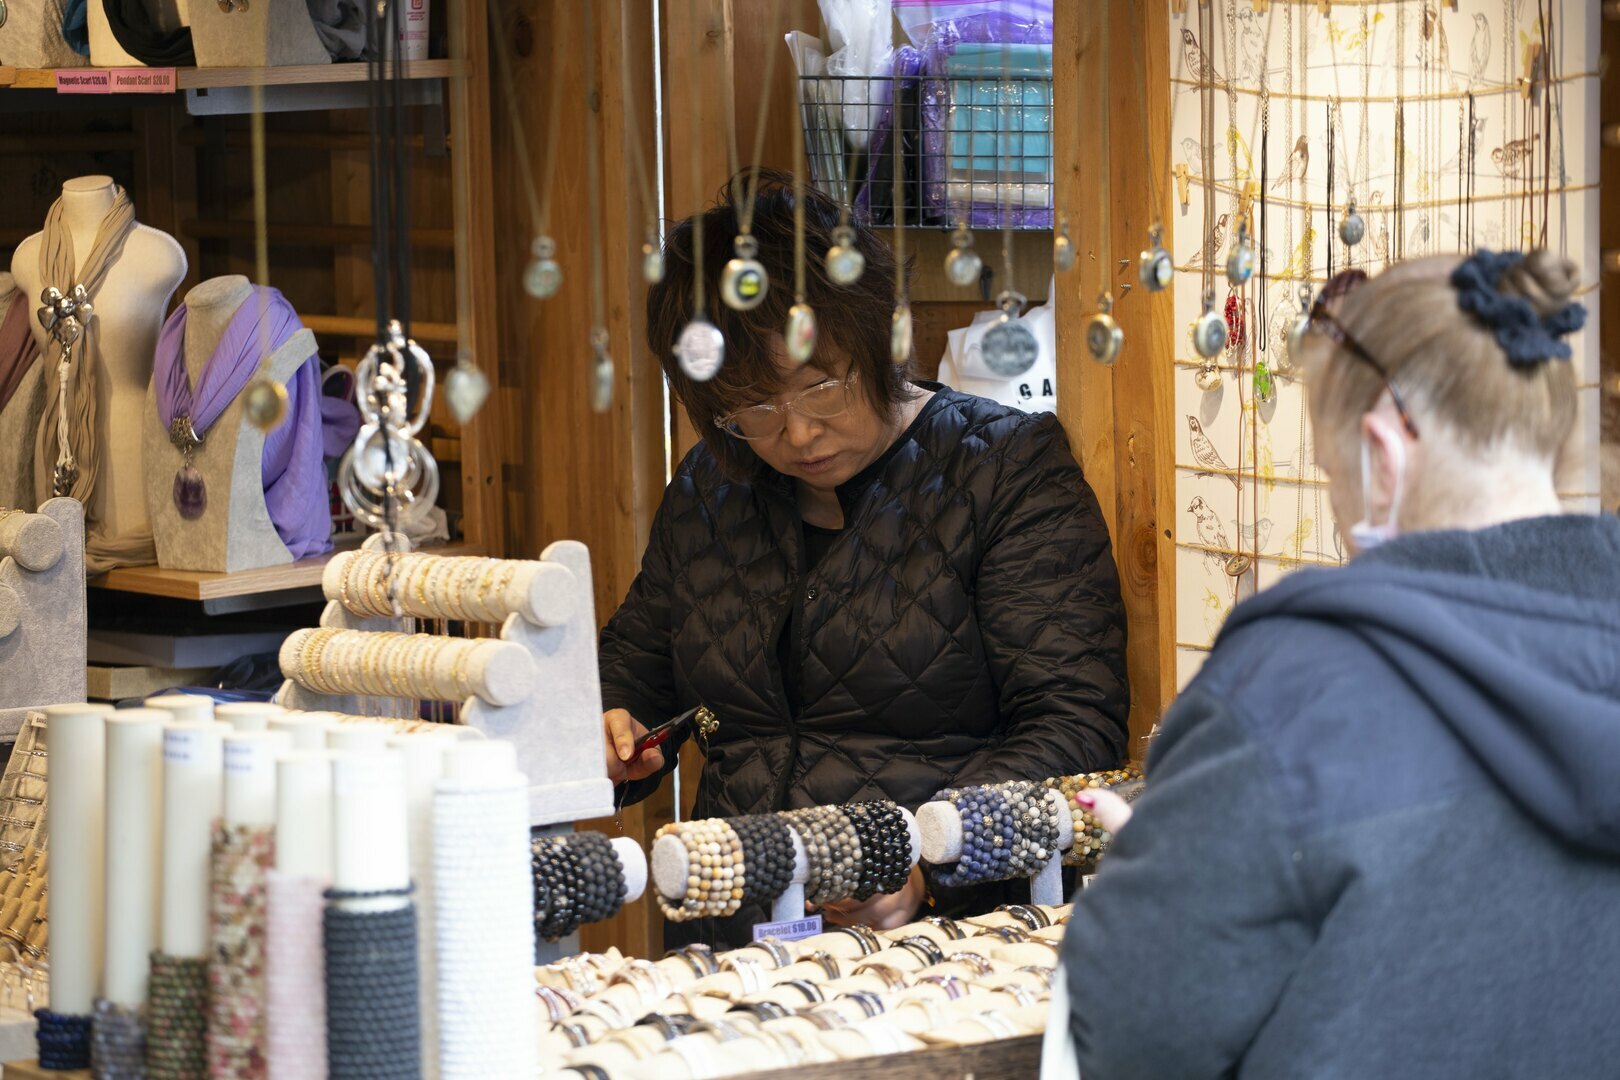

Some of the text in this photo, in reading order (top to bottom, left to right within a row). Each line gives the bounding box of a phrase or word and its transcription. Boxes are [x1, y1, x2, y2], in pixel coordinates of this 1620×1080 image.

[116, 75, 137, 86] Pendant
[138, 75, 152, 85] Scarf
[758, 925, 791, 938] Bracelet
